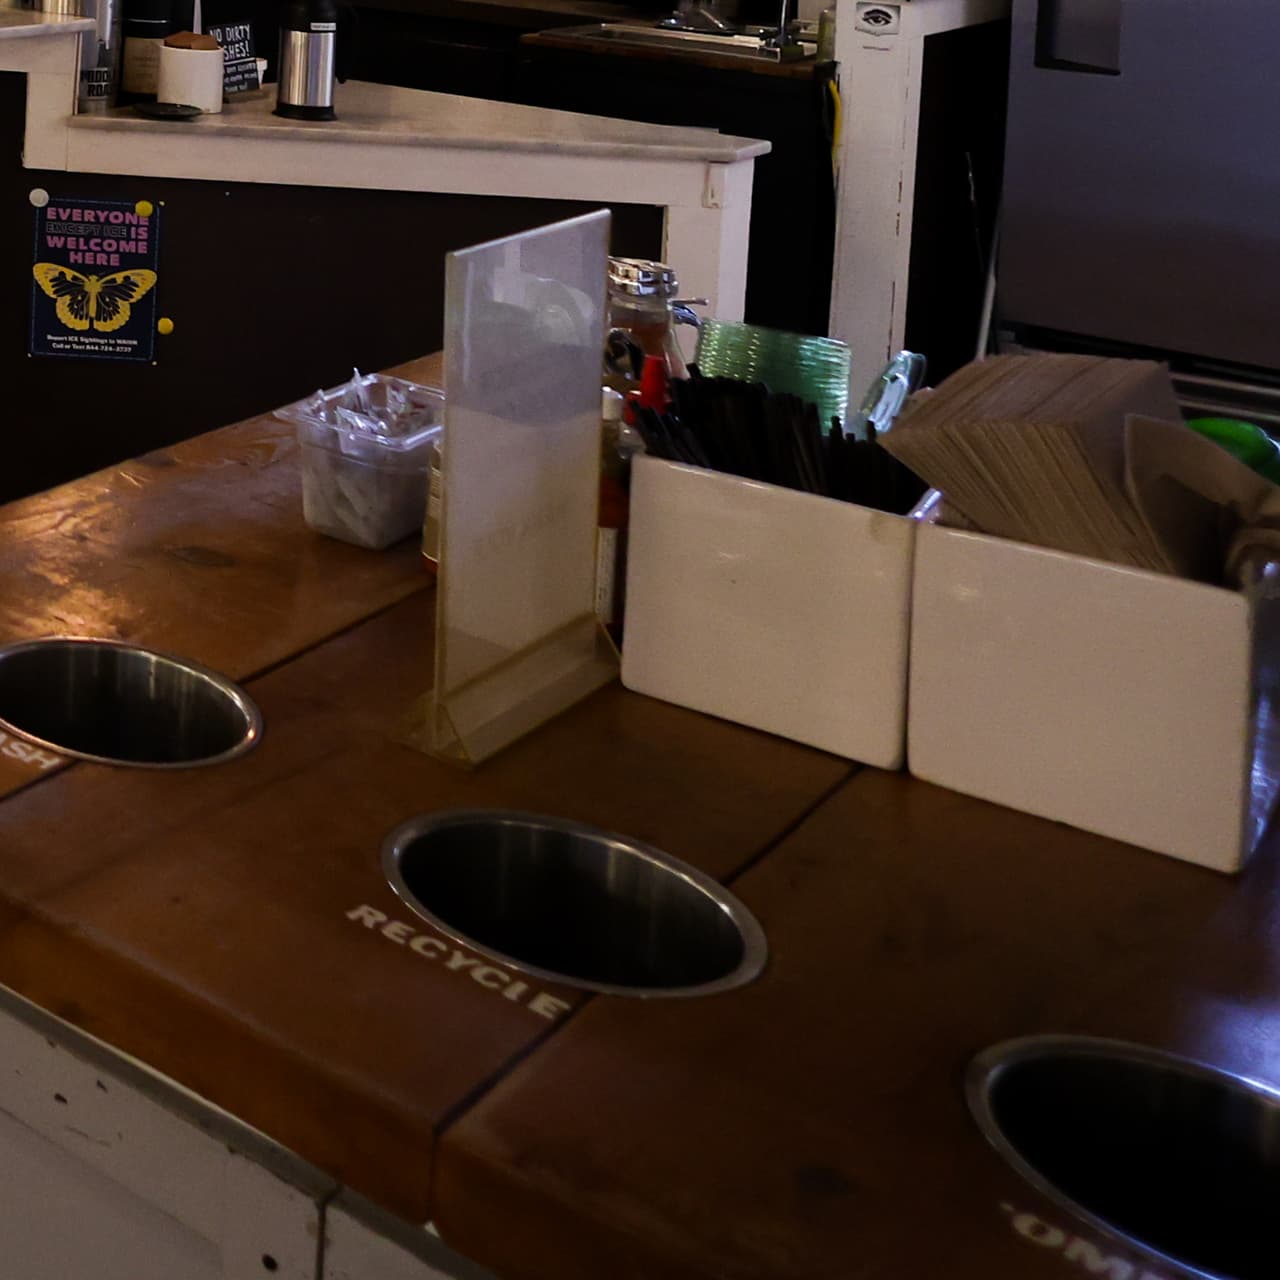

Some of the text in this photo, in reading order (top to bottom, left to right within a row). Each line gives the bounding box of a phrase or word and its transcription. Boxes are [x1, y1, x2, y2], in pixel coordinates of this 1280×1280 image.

[226, 24, 250, 41] DIRTY
[223, 39, 250, 61] SHES!
[46, 207, 149, 225] EVERYONE
[46, 222, 148, 239] EXCEPT ICE IS
[46, 235, 148, 254] WELCOME
[69, 251, 121, 266] HERE
[345, 904, 572, 1020] RECYCLE
